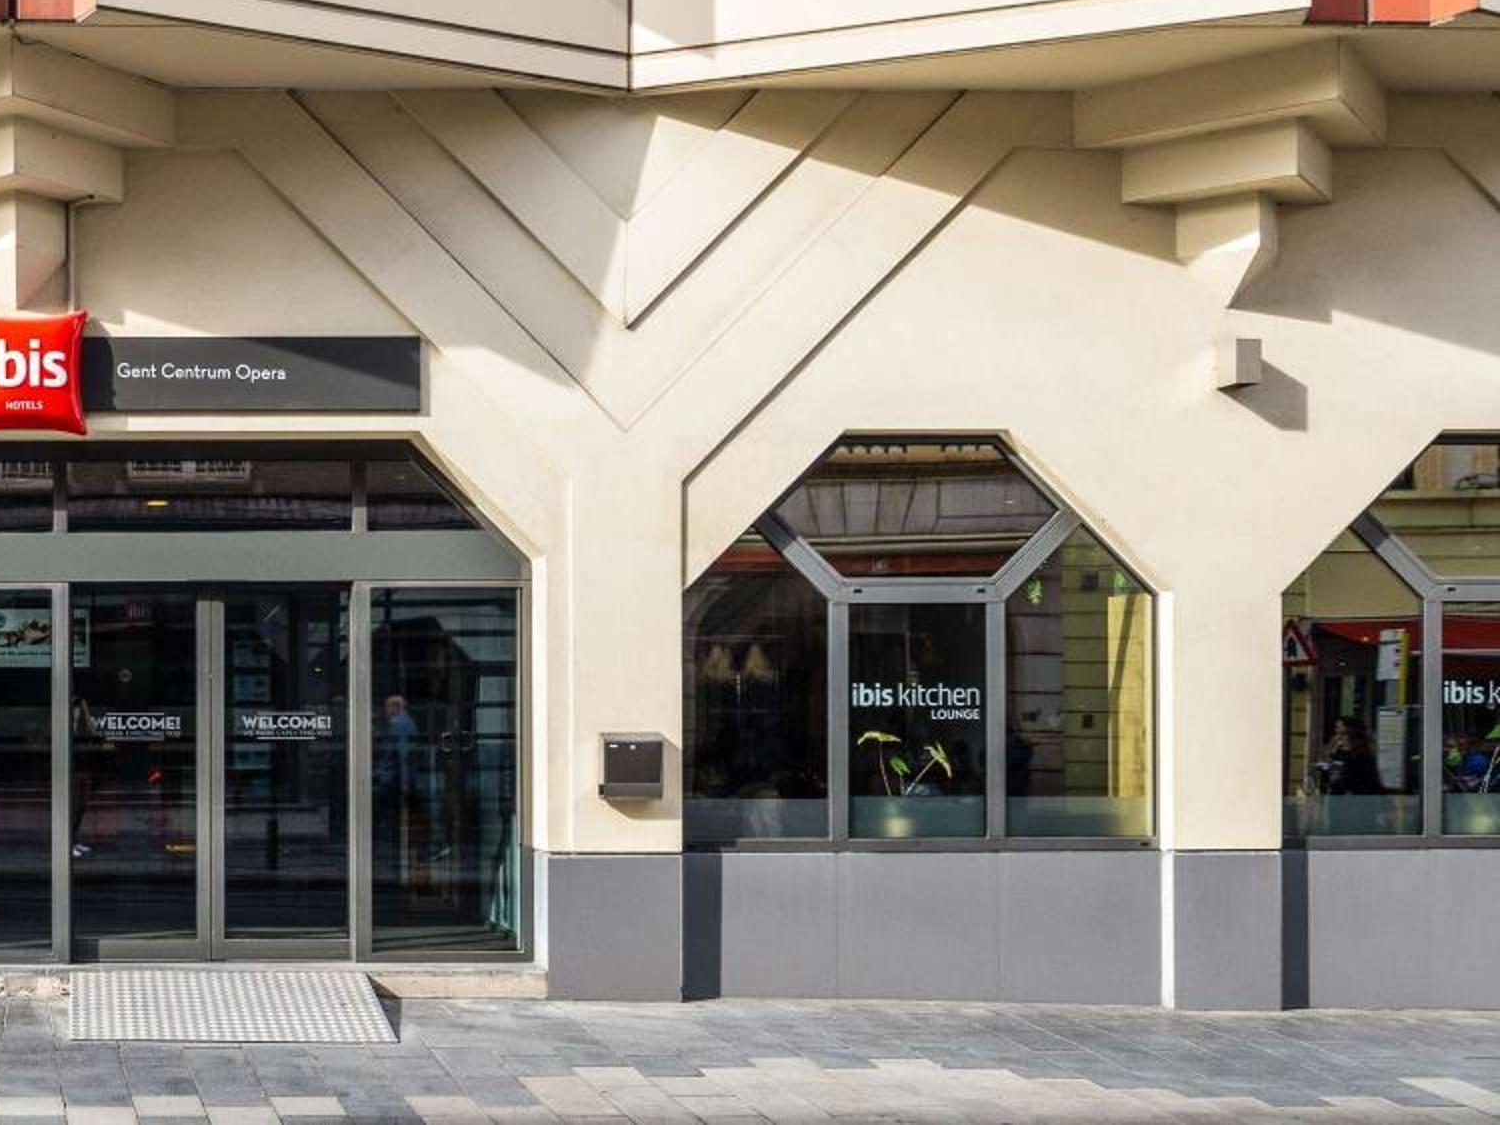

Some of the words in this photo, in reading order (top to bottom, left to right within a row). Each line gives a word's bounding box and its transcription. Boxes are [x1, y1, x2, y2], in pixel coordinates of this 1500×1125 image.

[116, 362, 156, 379] Gent
[160, 362, 231, 380] Centrum
[235, 364, 287, 385] Opera
[5, 400, 43, 410] HOTELS
[851, 682, 894, 707] ibis
[897, 682, 980, 707] kitchen
[1443, 680, 1486, 704] ibis
[931, 708, 980, 720] LOUNGE
[90, 716, 181, 730] WELCOME!
[242, 715, 331, 729] WELCOME!
